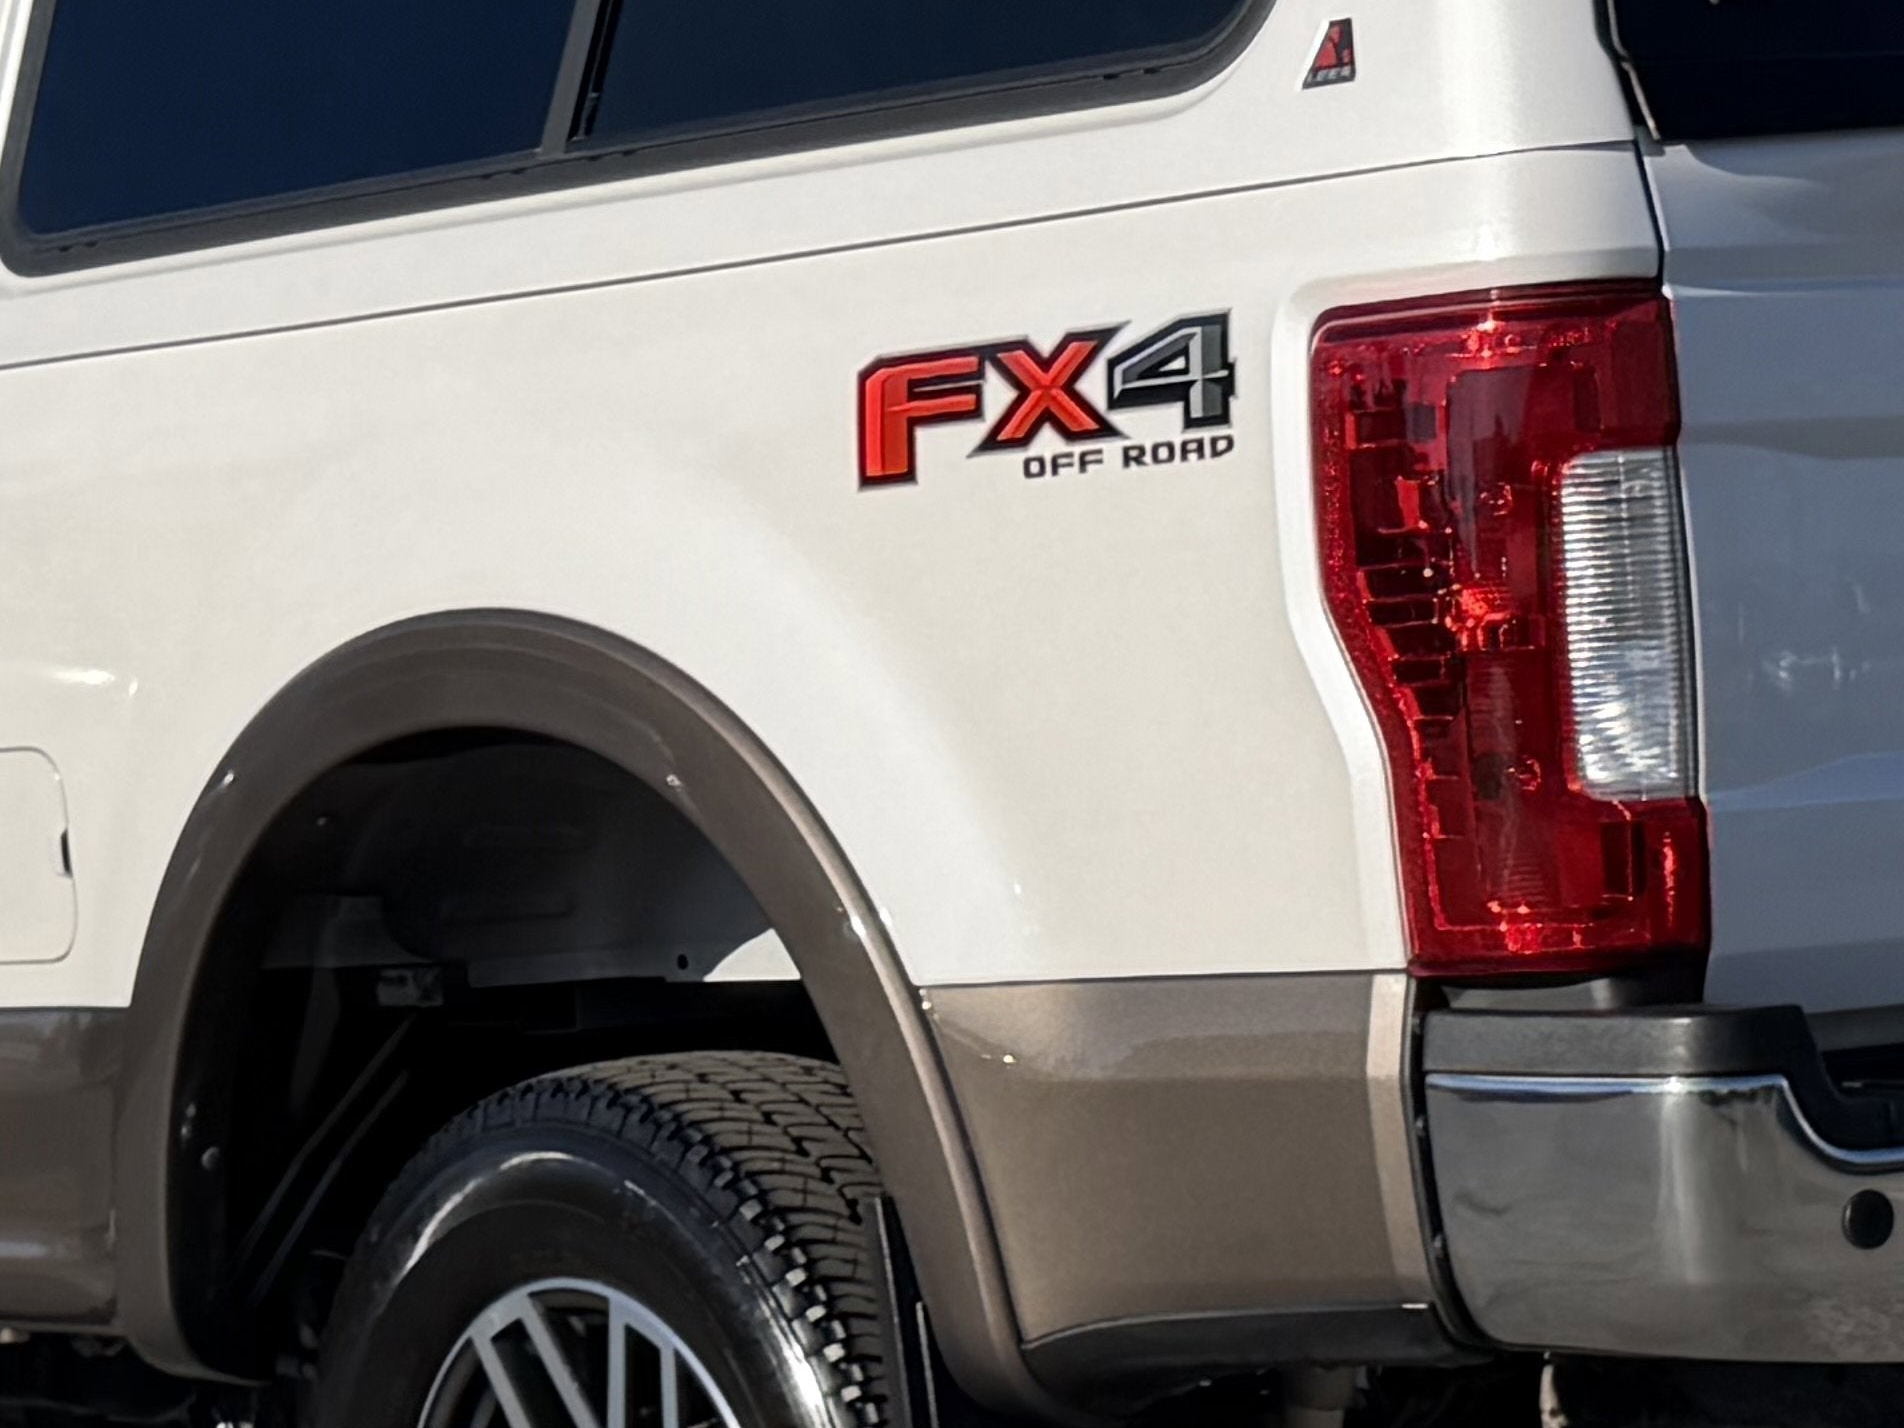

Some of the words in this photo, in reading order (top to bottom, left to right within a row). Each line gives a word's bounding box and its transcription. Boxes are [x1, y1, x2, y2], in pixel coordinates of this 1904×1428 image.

[857, 307, 1237, 492] FX4
[1022, 448, 1104, 480] OFF
[1122, 433, 1236, 470] ROAD
